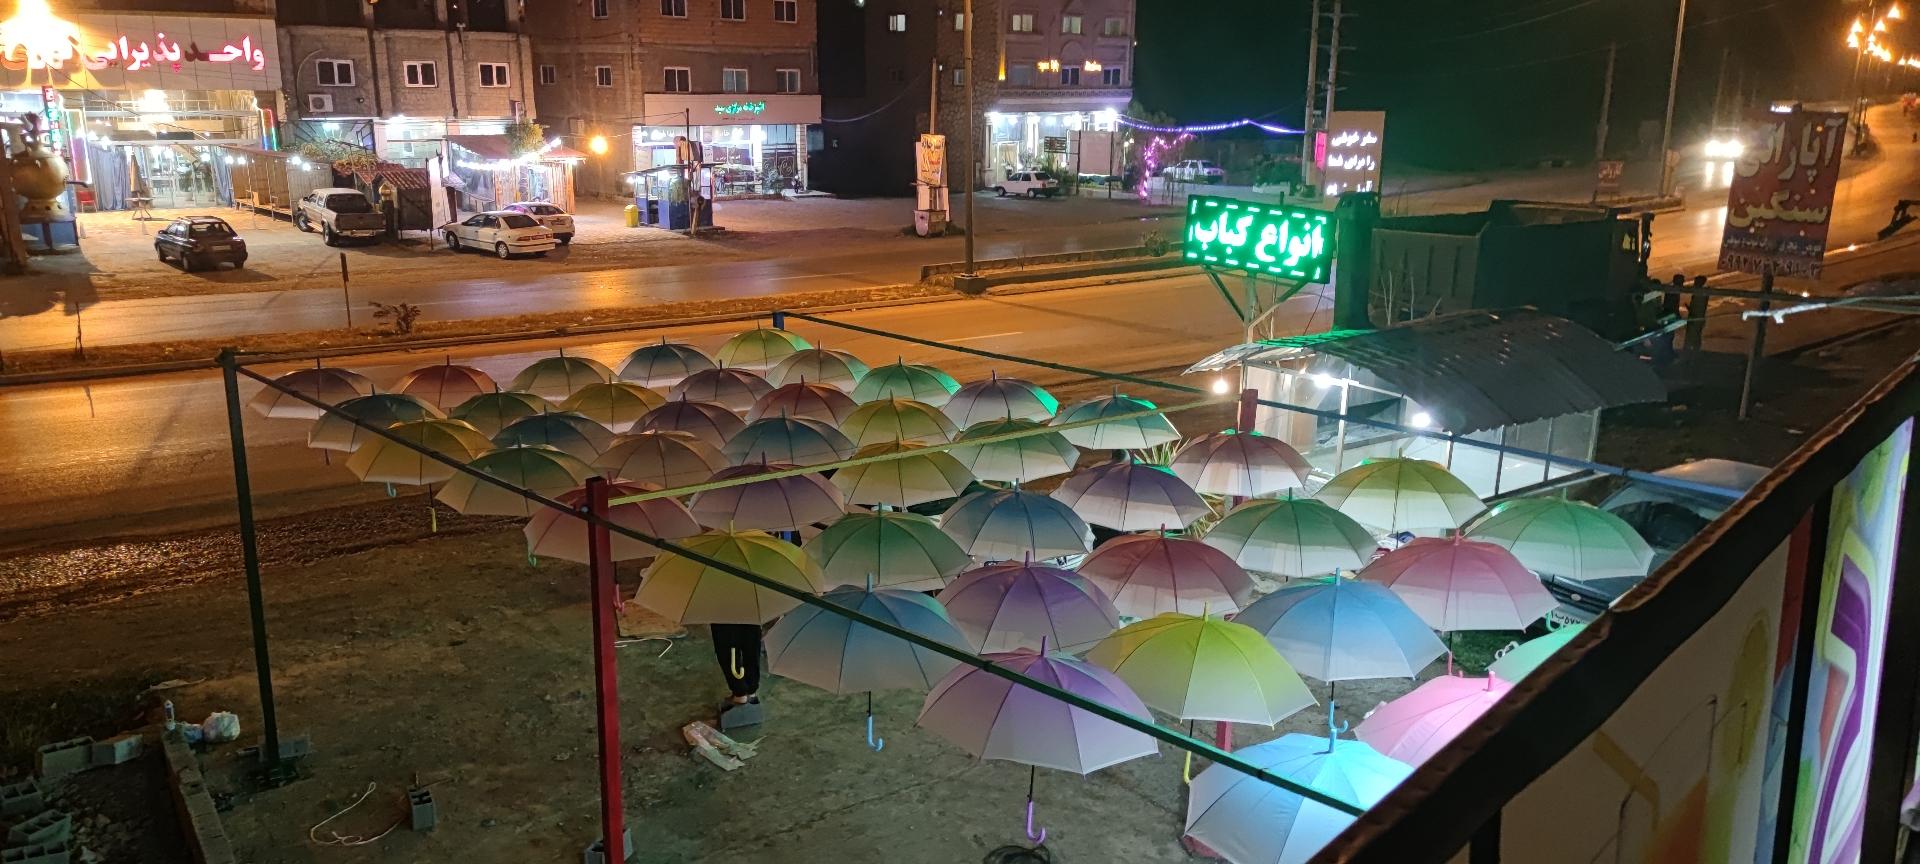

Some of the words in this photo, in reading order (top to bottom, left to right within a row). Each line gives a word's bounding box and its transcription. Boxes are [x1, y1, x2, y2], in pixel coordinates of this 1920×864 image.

[83, 33, 182, 72] پذیرایی
[185, 35, 265, 71] واحد
[1360, 131, 1378, 147] سفر
[1736, 117, 1846, 183] آپاراتی
[1327, 153, 1344, 167] شما
[1366, 154, 1376, 171] را
[1728, 189, 1829, 229] سنگین
[1194, 211, 1254, 254] کباب
[1255, 218, 1325, 267] انواع
